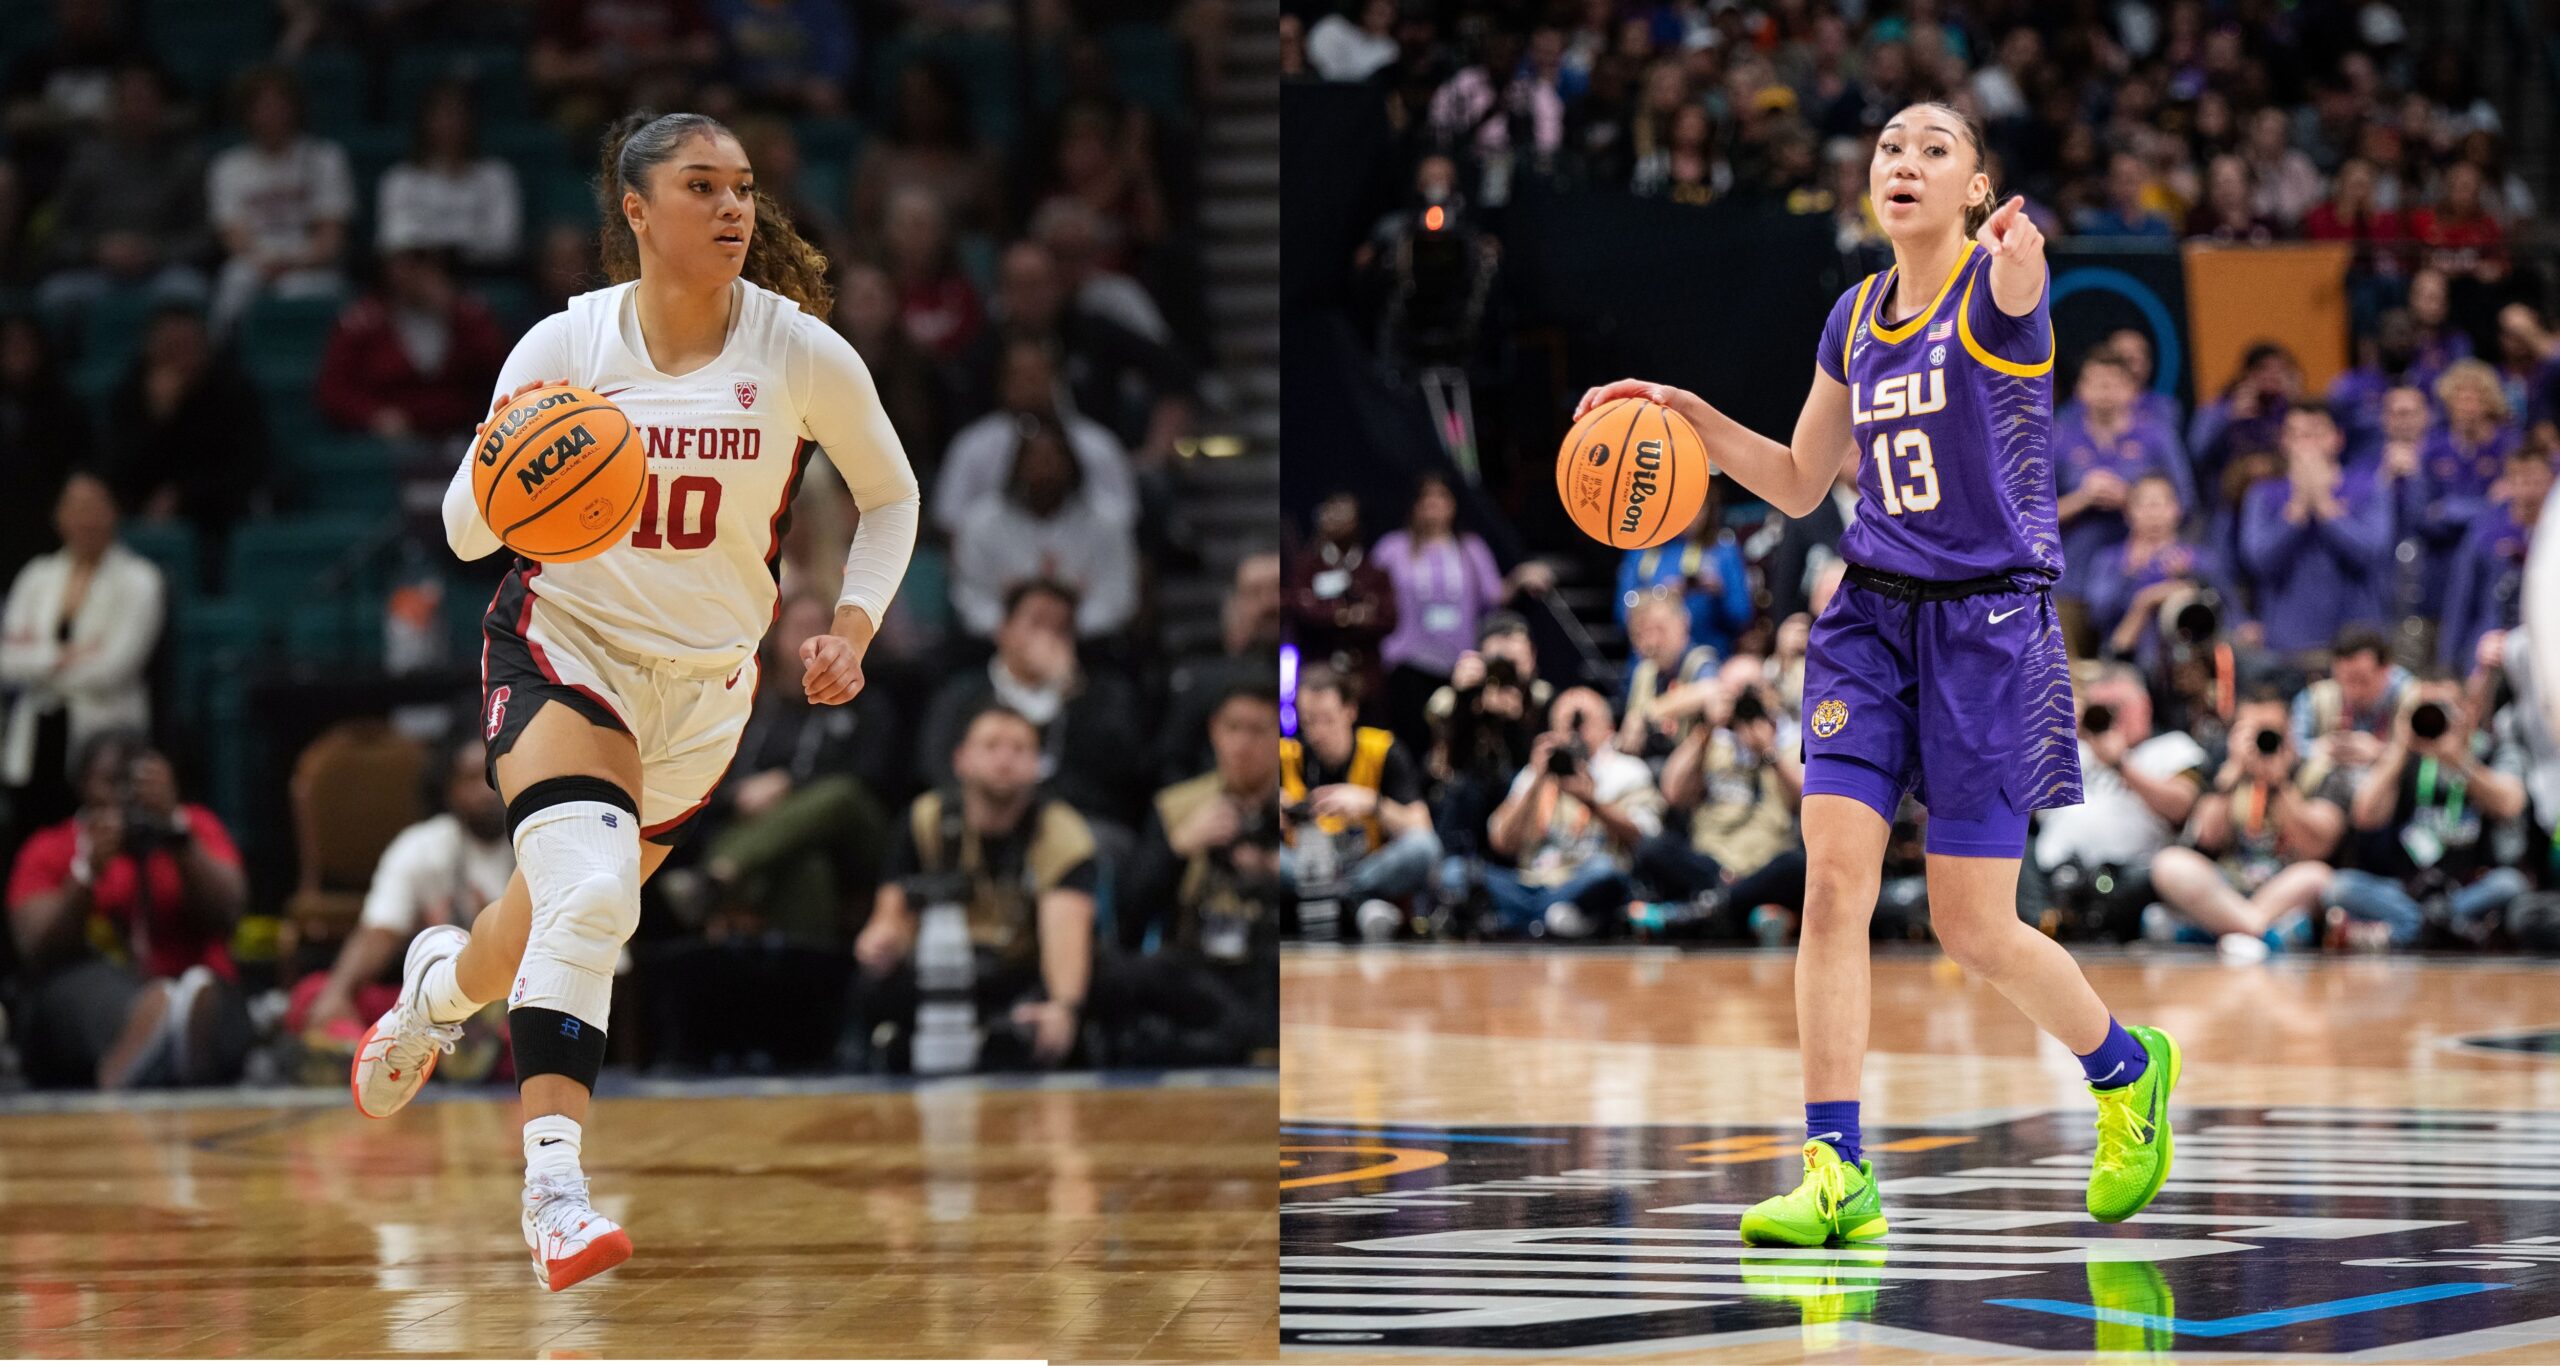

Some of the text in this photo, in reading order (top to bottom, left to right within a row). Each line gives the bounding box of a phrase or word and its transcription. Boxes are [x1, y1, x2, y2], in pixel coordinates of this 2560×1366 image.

[735, 382, 758, 398] PAC
[740, 393, 752, 404] 12
[1852, 368, 1947, 426] LSU
[479, 392, 580, 467] Wilson
[516, 424, 597, 496] NCAA
[635, 426, 761, 460] NFORD
[530, 477, 559, 502] OFFICIAL
[582, 447, 601, 460] BALL
[1619, 439, 1662, 533] Wilson
[1873, 428, 1941, 515] 13
[631, 474, 722, 550] 10
